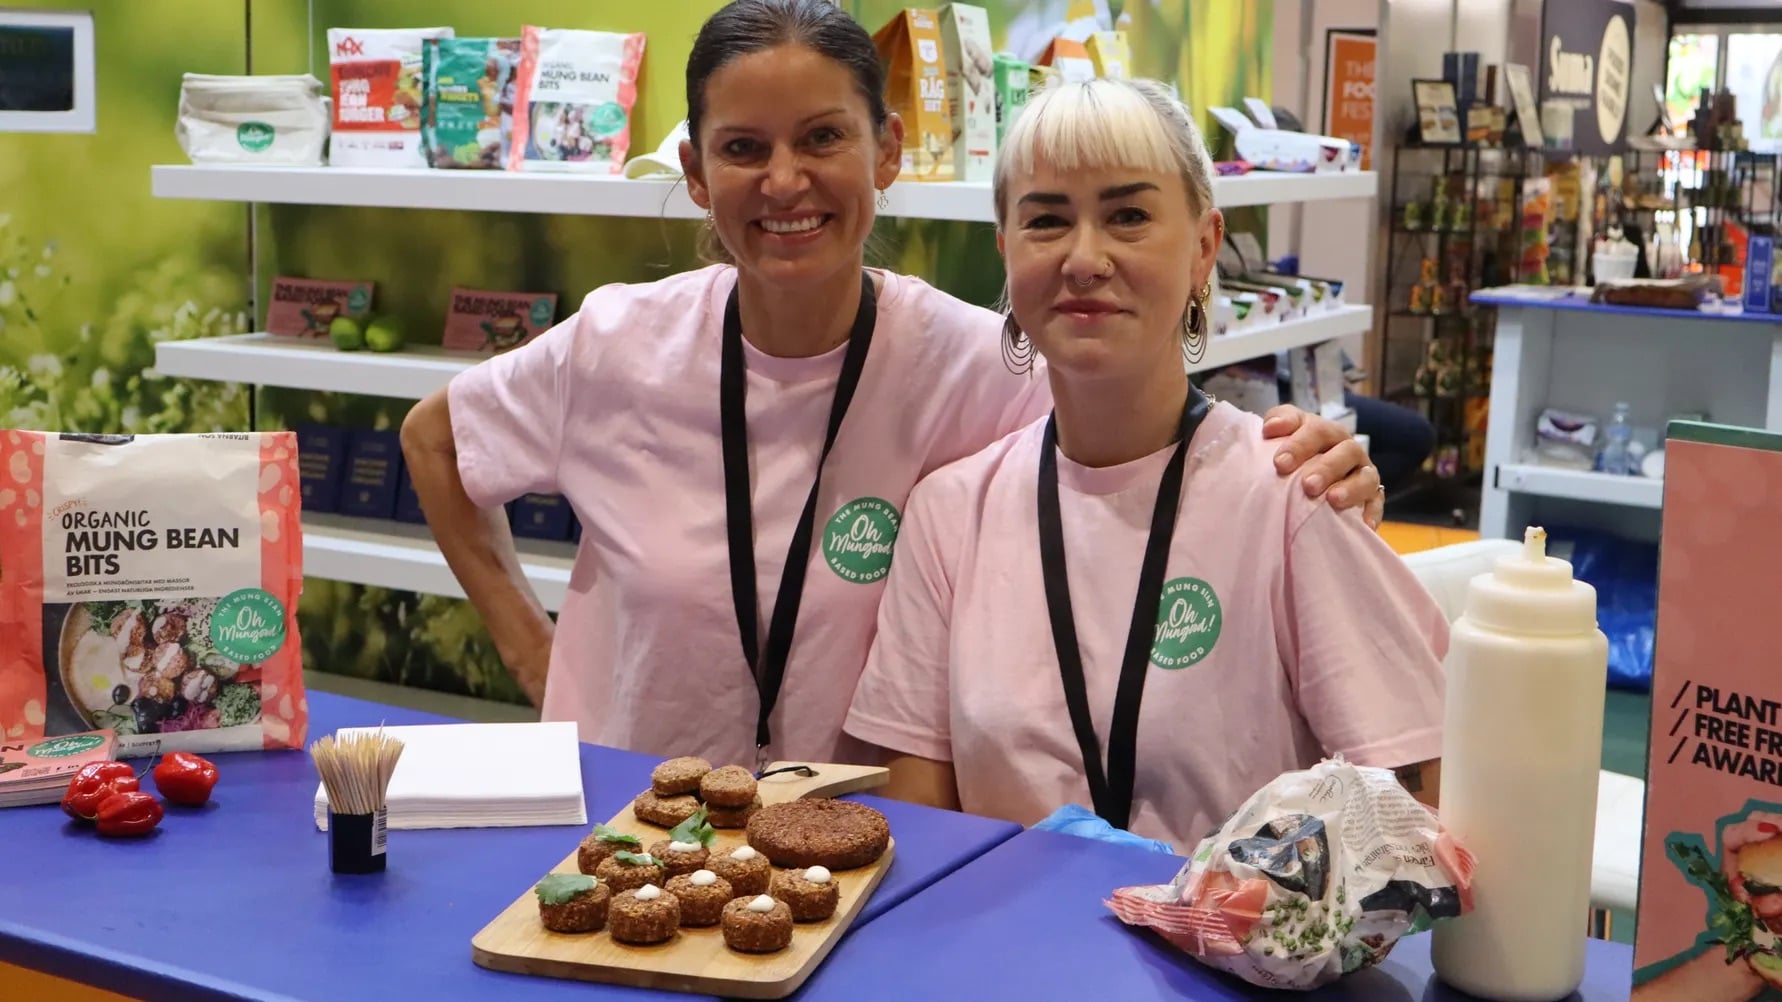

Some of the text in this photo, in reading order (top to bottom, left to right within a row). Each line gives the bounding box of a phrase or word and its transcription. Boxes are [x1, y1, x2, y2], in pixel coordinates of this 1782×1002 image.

[537, 80, 560, 90] BITS
[541, 69, 610, 83] MUNG BEAN
[62, 509, 151, 530] ORGANIC
[835, 509, 851, 524] THE
[853, 502, 881, 511] MUNG
[850, 514, 882, 541] Oh
[66, 528, 240, 553] MUNG BEAN
[66, 553, 120, 577] BITS
[831, 557, 886, 580] BASED FOOD
[218, 593, 282, 617] THE MUNG BEAN
[1167, 583, 1214, 608] MUNG BEAN
[236, 606, 266, 630] Oh
[1169, 598, 1199, 628] Oh
[223, 645, 276, 661] BASED FOOD
[1176, 646, 1204, 665] FOOD
[1696, 684, 1782, 726] PLANT
[1695, 712, 1751, 749] FREE
